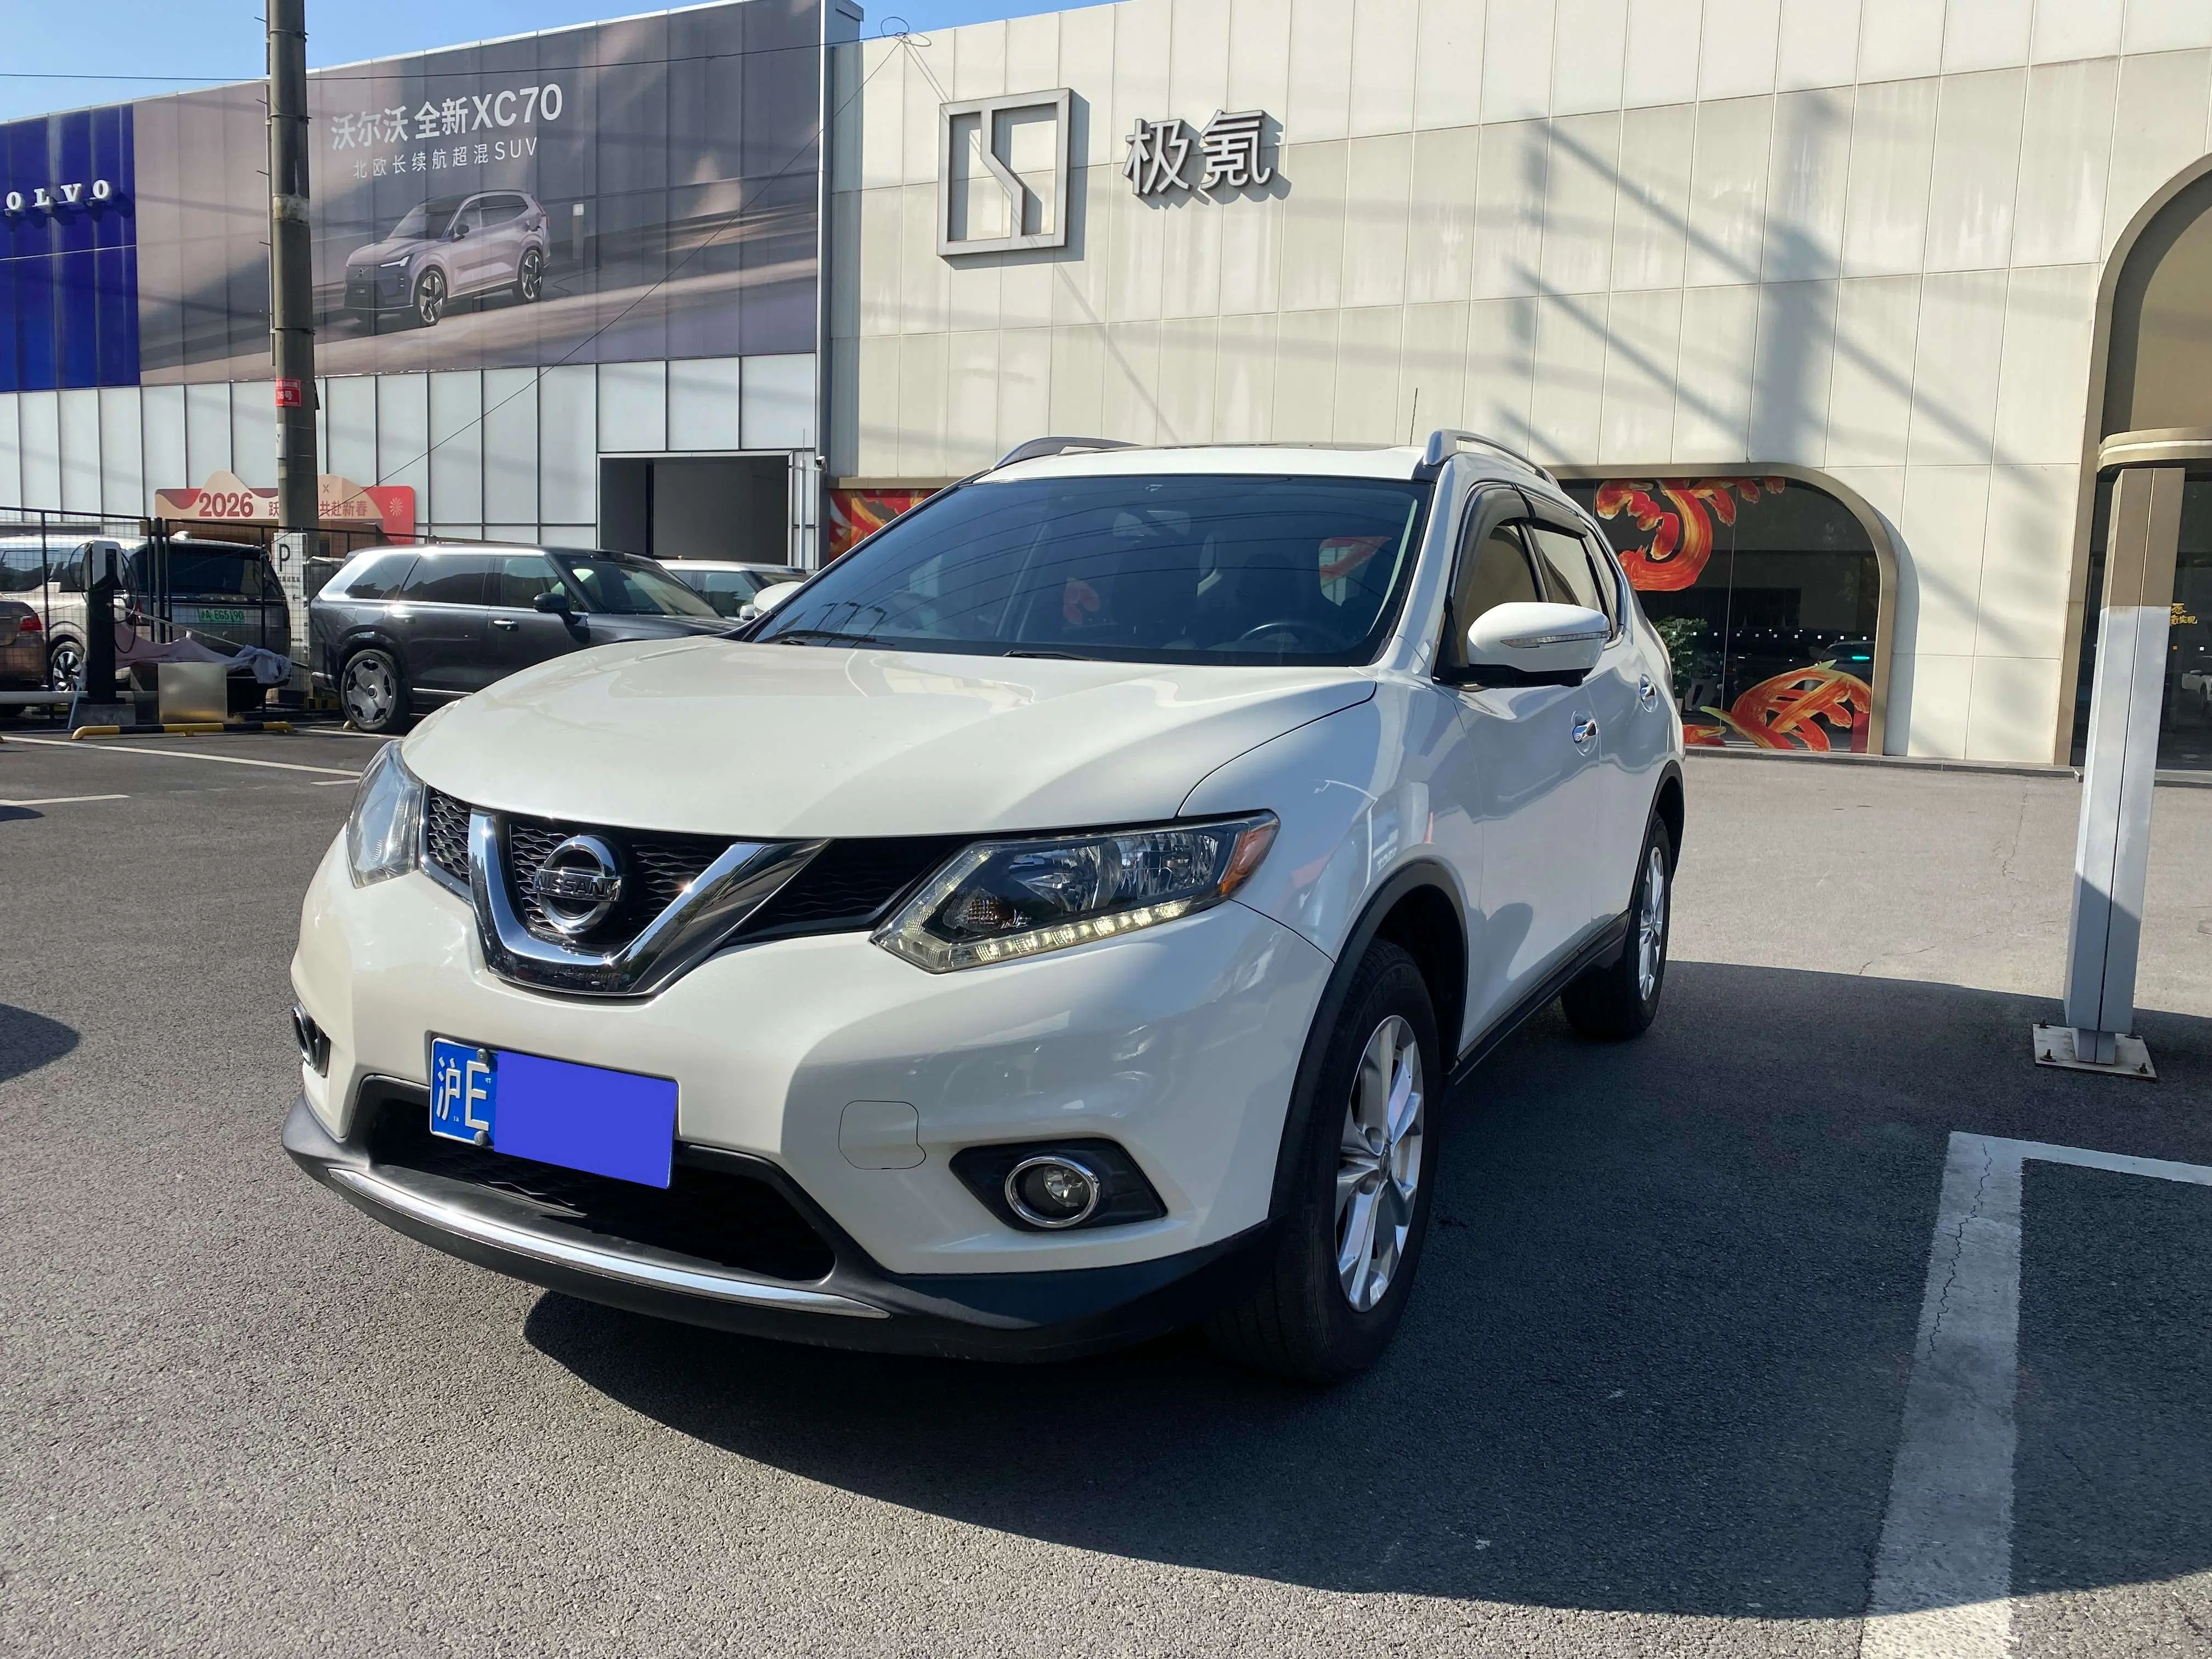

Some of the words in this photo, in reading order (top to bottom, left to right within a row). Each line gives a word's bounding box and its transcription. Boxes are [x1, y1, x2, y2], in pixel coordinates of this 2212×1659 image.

[353, 137, 538, 179] 北欧长续航超混SUV
[1122, 109, 1273, 195] 极氪
[199, 492, 253, 517] 2026
[319, 500, 368, 517] 共赴新春
[279, 544, 290, 572] P
[537, 871, 606, 898] NISSAN
